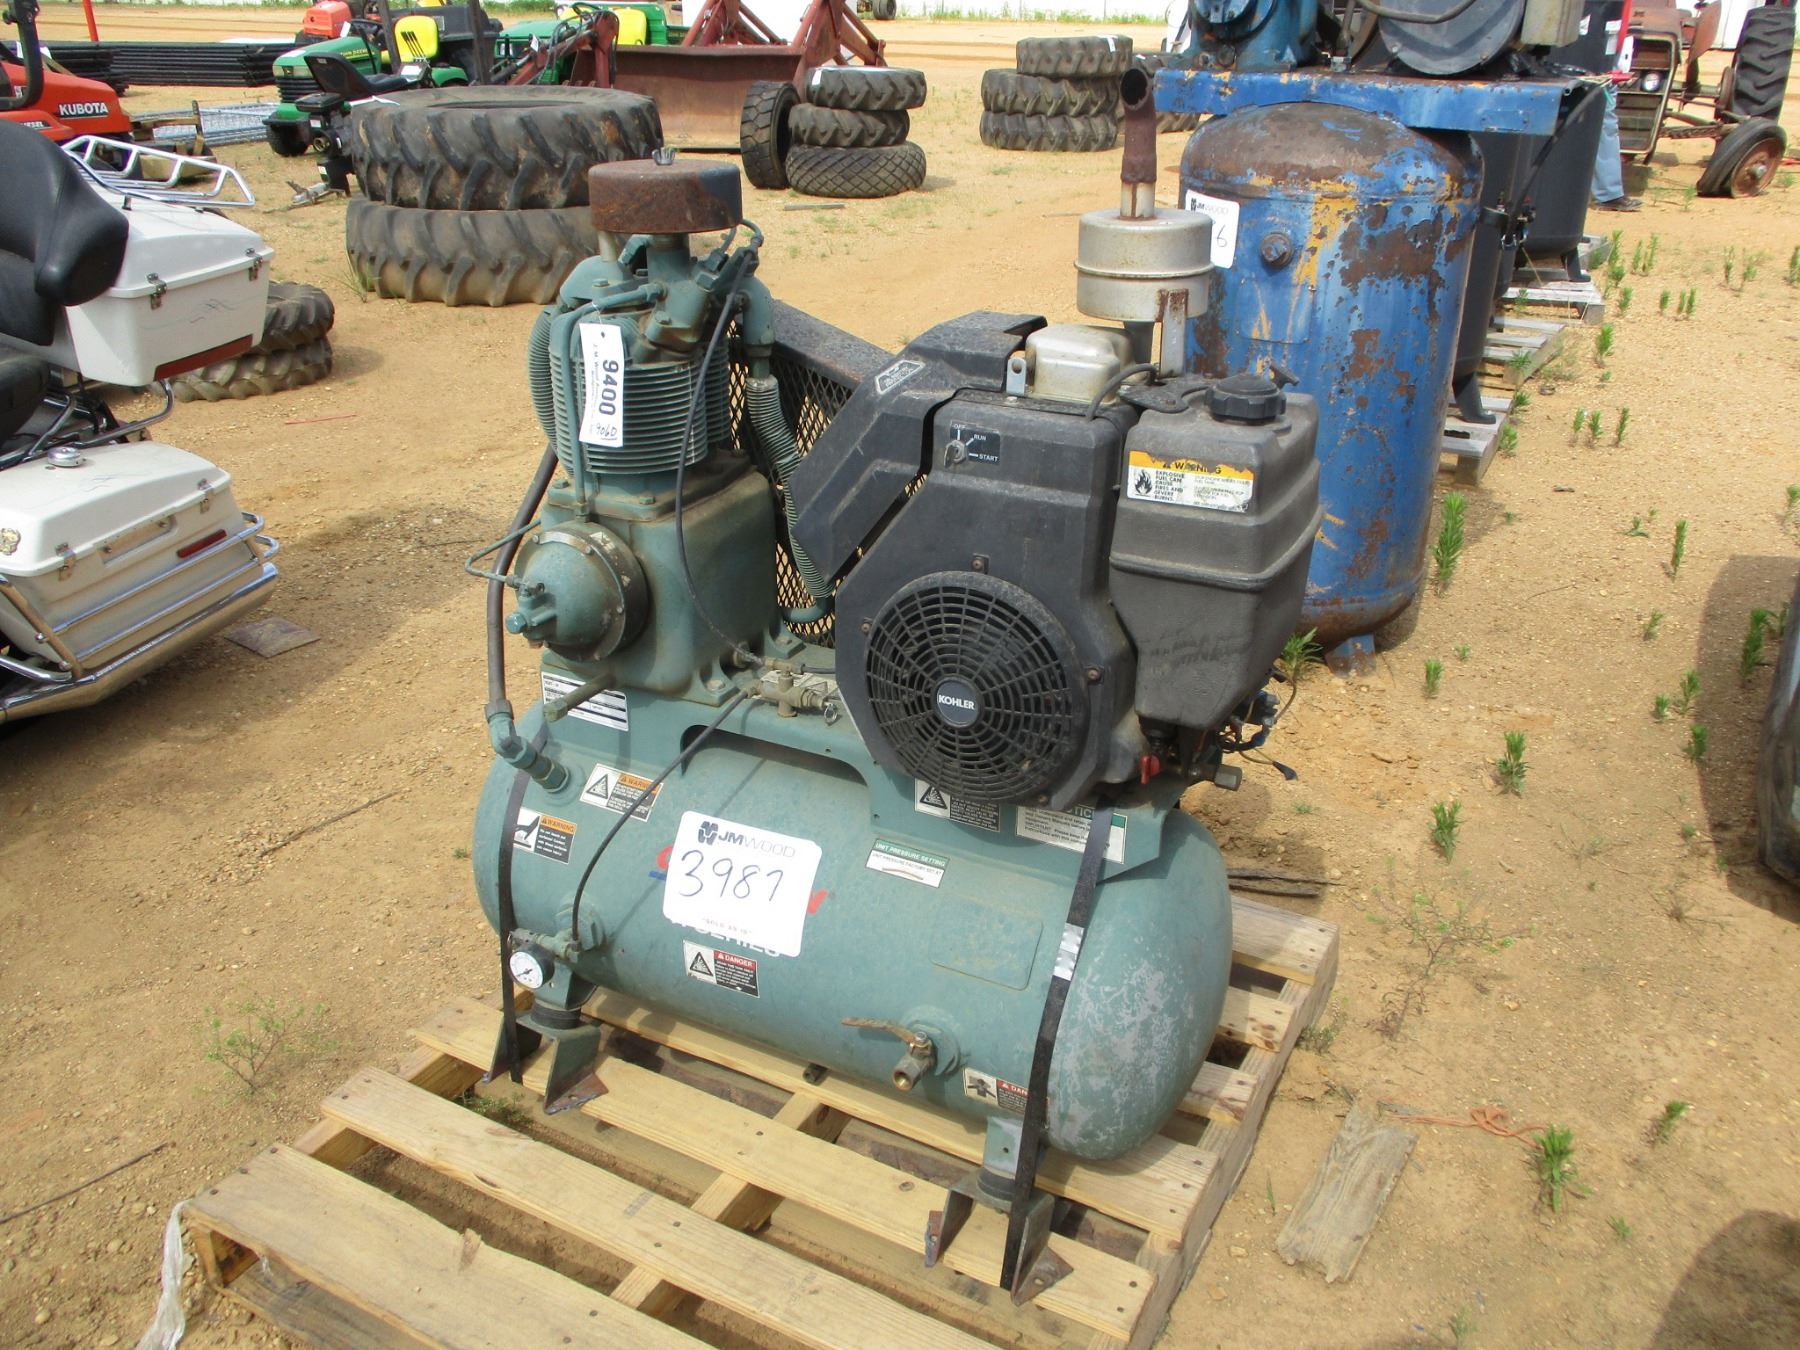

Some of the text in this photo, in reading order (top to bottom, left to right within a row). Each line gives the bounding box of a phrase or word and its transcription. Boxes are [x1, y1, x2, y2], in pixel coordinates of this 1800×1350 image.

[59, 103, 108, 116] KUBOTA
[1214, 221, 1228, 247] 6
[598, 360, 619, 416] 9400
[979, 453, 998, 462] START
[1155, 470, 1185, 479] EXPLOSIVE
[938, 694, 975, 711] KOHLER
[548, 819, 575, 833] WARNING
[718, 831, 796, 858] JMWOOD
[876, 843, 945, 867] UNIT PRESSURE SETTING
[679, 849, 784, 902] 3987
[725, 955, 753, 967] DANGER
